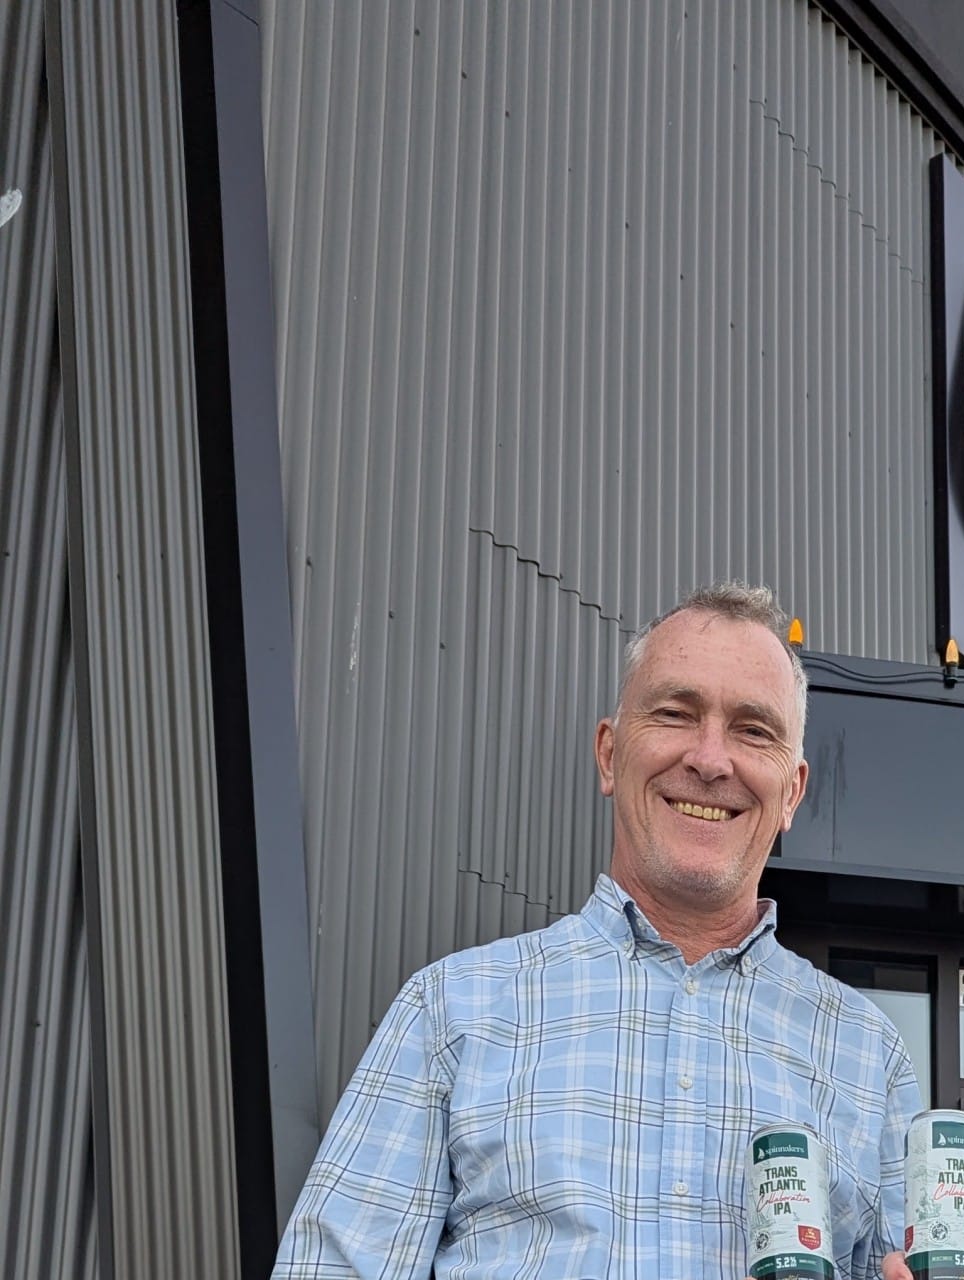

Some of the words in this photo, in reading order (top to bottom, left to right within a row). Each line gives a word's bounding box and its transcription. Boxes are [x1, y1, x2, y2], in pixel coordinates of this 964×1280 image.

[765, 1145, 805, 1155] spinnakers
[764, 1166, 798, 1180] TRANS
[759, 1179, 806, 1196] ATLANTIC
[757, 1190, 810, 1212] Collaboration
[774, 1202, 791, 1215] IPA
